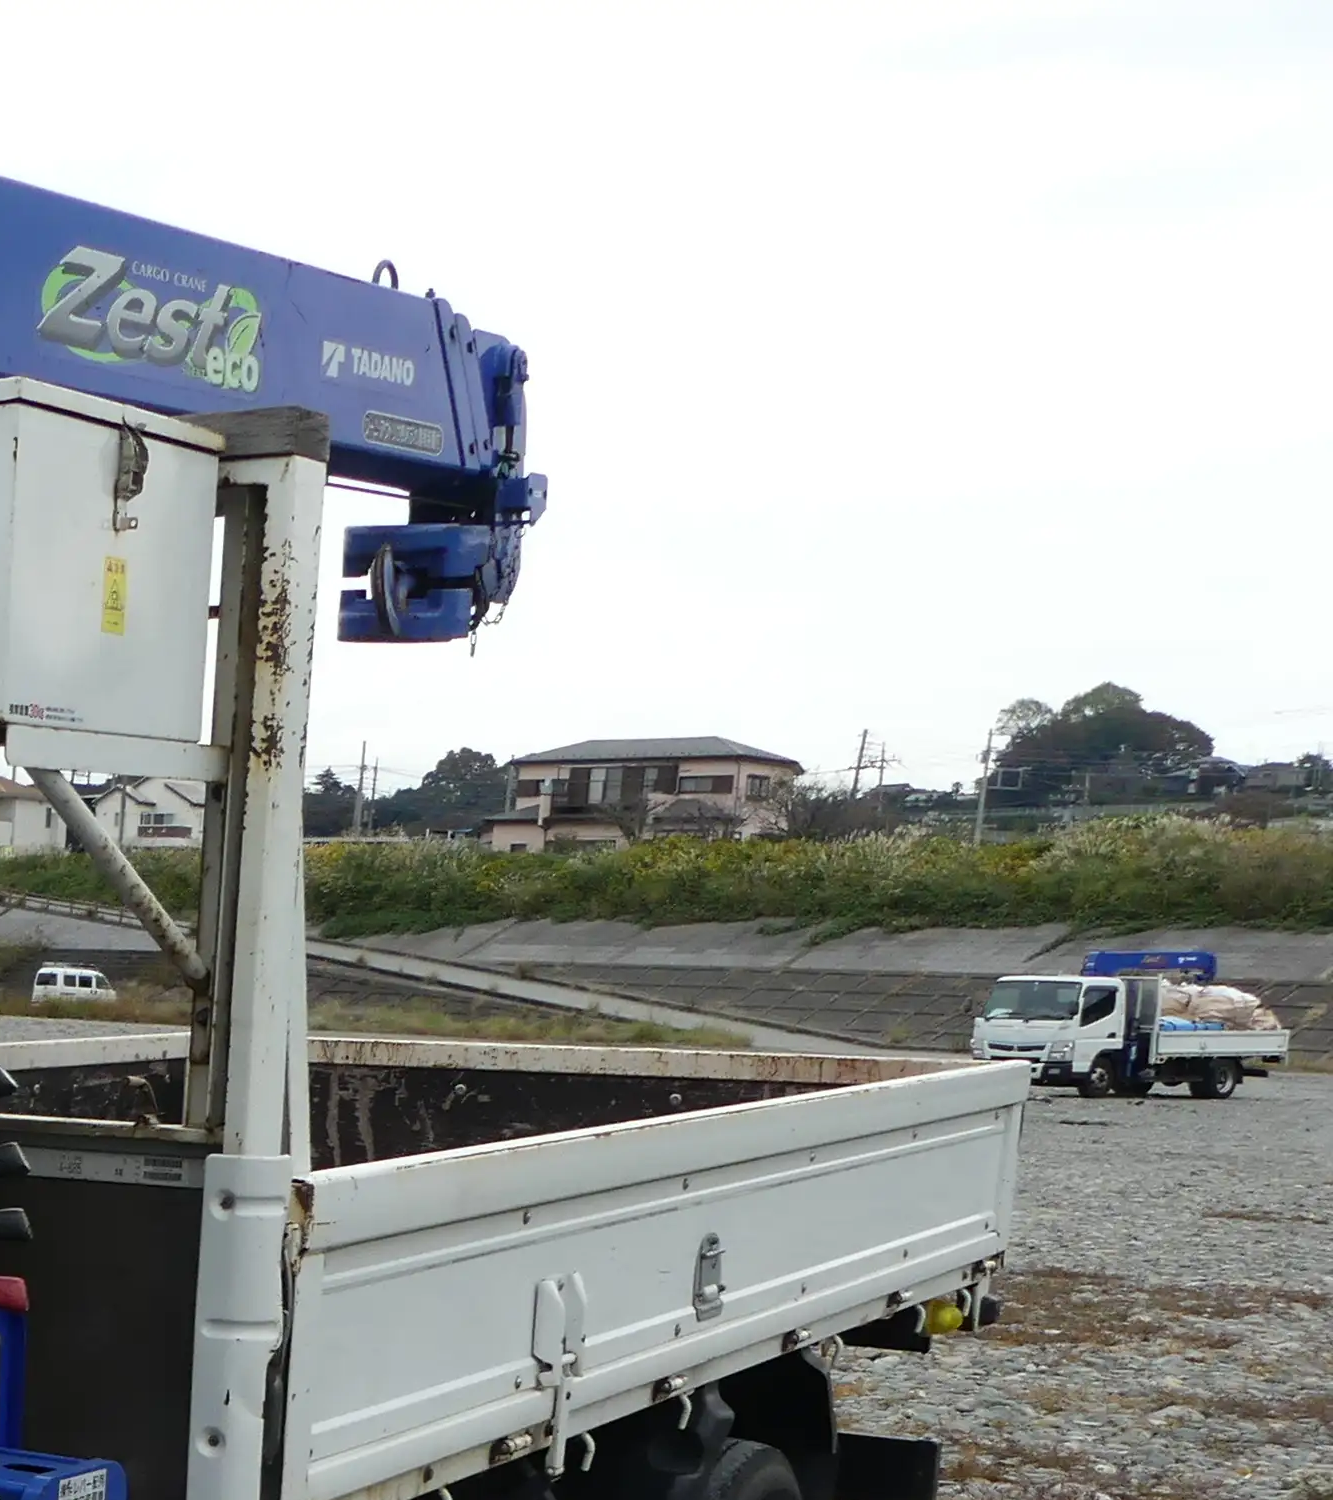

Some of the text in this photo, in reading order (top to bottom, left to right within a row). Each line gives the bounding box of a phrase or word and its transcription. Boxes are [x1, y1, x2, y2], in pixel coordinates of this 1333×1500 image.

[131, 259, 208, 293] CARGO CRANE
[37, 245, 235, 368] Zest
[205, 346, 260, 393] eco
[351, 346, 415, 387] TADANO
